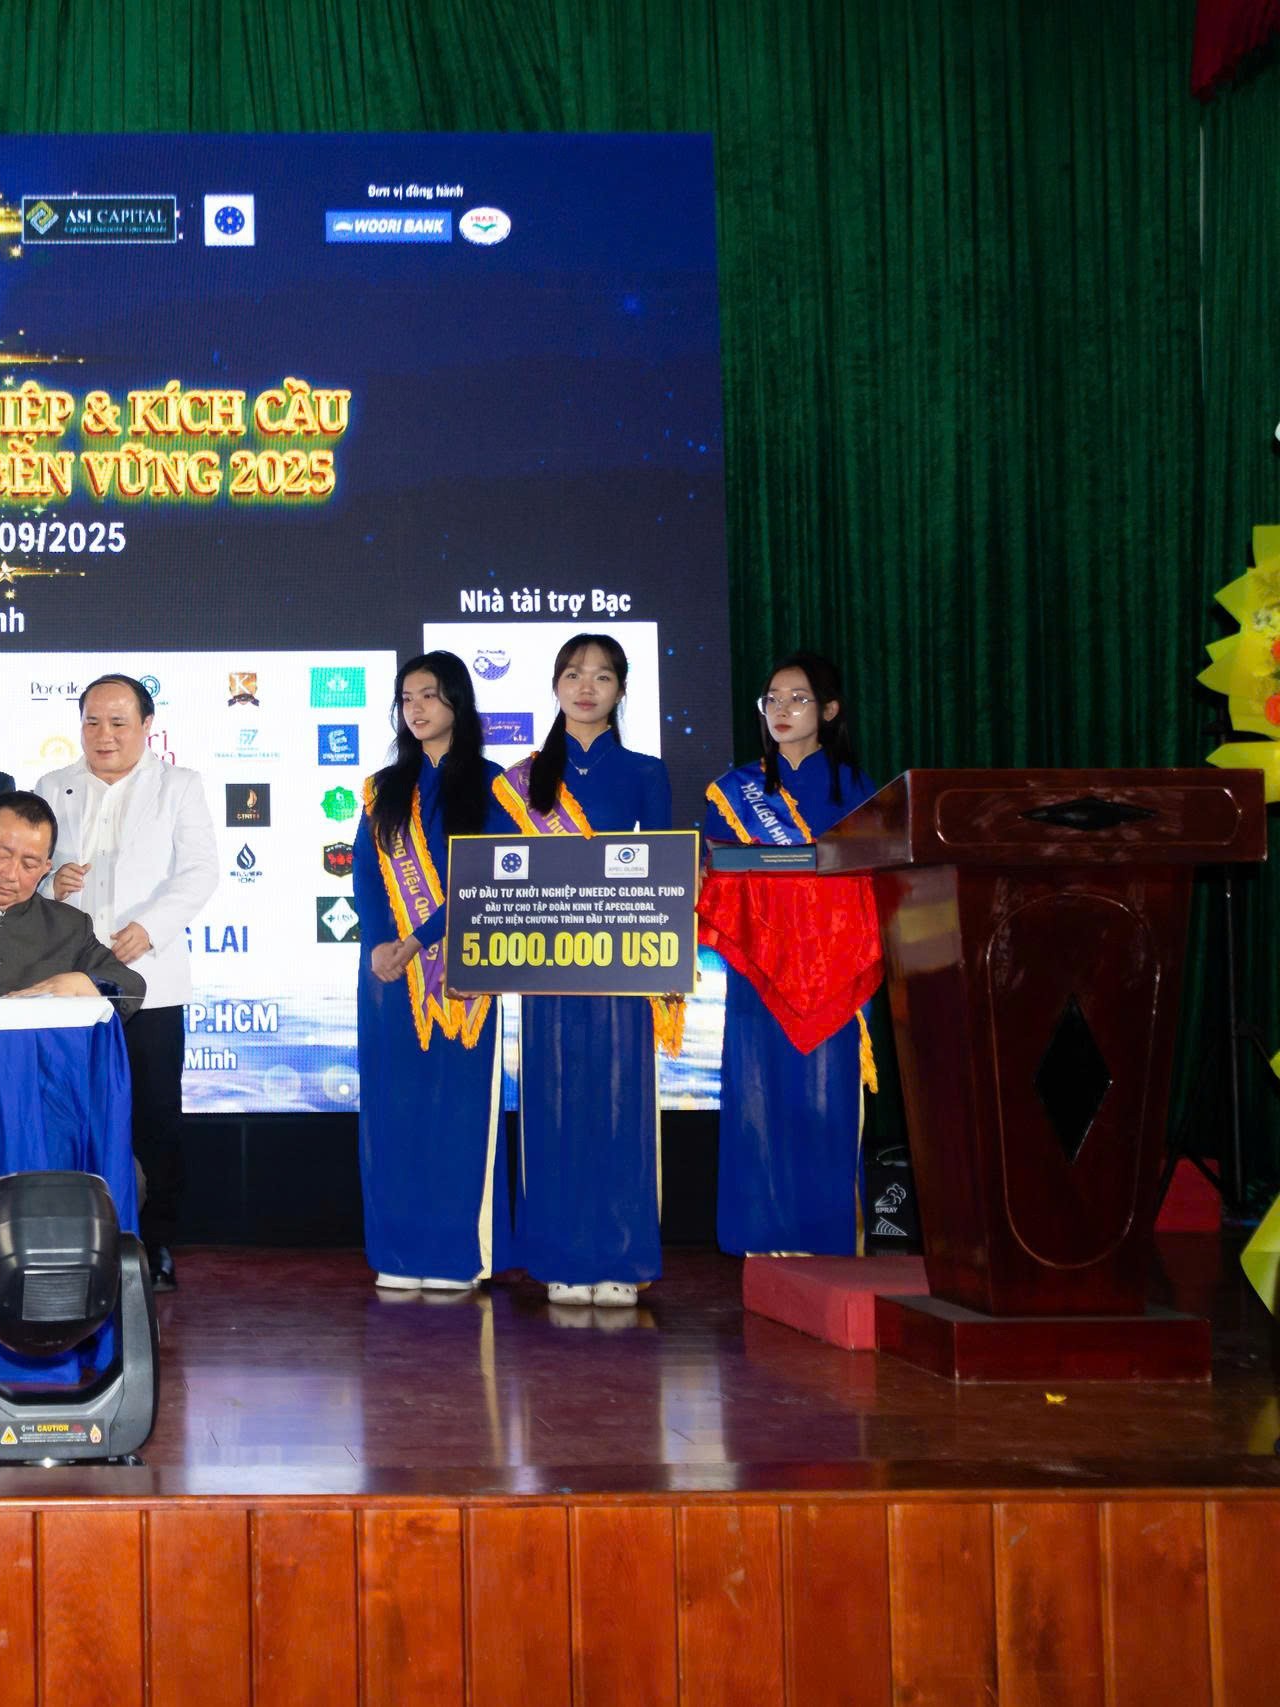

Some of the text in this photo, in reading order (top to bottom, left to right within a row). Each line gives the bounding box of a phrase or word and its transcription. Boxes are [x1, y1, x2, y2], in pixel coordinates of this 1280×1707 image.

[66, 208, 167, 223] ASI CAPITAL
[354, 218, 445, 233] WOORI BANK
[82, 391, 121, 438] &
[127, 380, 247, 438] KÍCH
[254, 376, 351, 438] CẦU
[80, 442, 224, 498] VỮNG
[230, 450, 336, 498] 2025
[460, 587, 631, 618] Nhà tài trợ Bạc
[399, 859, 421, 896] Hiệu
[459, 884, 685, 900] QUỸ ĐẦU TƯ KHỞI NGHIỆP UNEEDC GLOBAL FUND
[483, 915, 504, 926] THỰC
[505, 913, 524, 926] HIỆN
[525, 915, 559, 925] CHƯƠNG
[560, 913, 584, 924] TRÌNH
[586, 912, 602, 924] ĐẦU
[604, 915, 616, 923] TƯ
[617, 912, 637, 923] KHỞI
[639, 912, 670, 925] NGHIỆP
[485, 900, 656, 913] ĐẦU TƯ CHO TẬP ĐOÀN KINH TẾ APECGLOBAL
[205, 926, 249, 953] LAI
[462, 931, 613, 967] 5.000.000
[622, 931, 679, 967] USD
[184, 1003, 279, 1033] P.HCM
[184, 1047, 238, 1071] Minh
[37, 1423, 69, 1433] CAUTION
